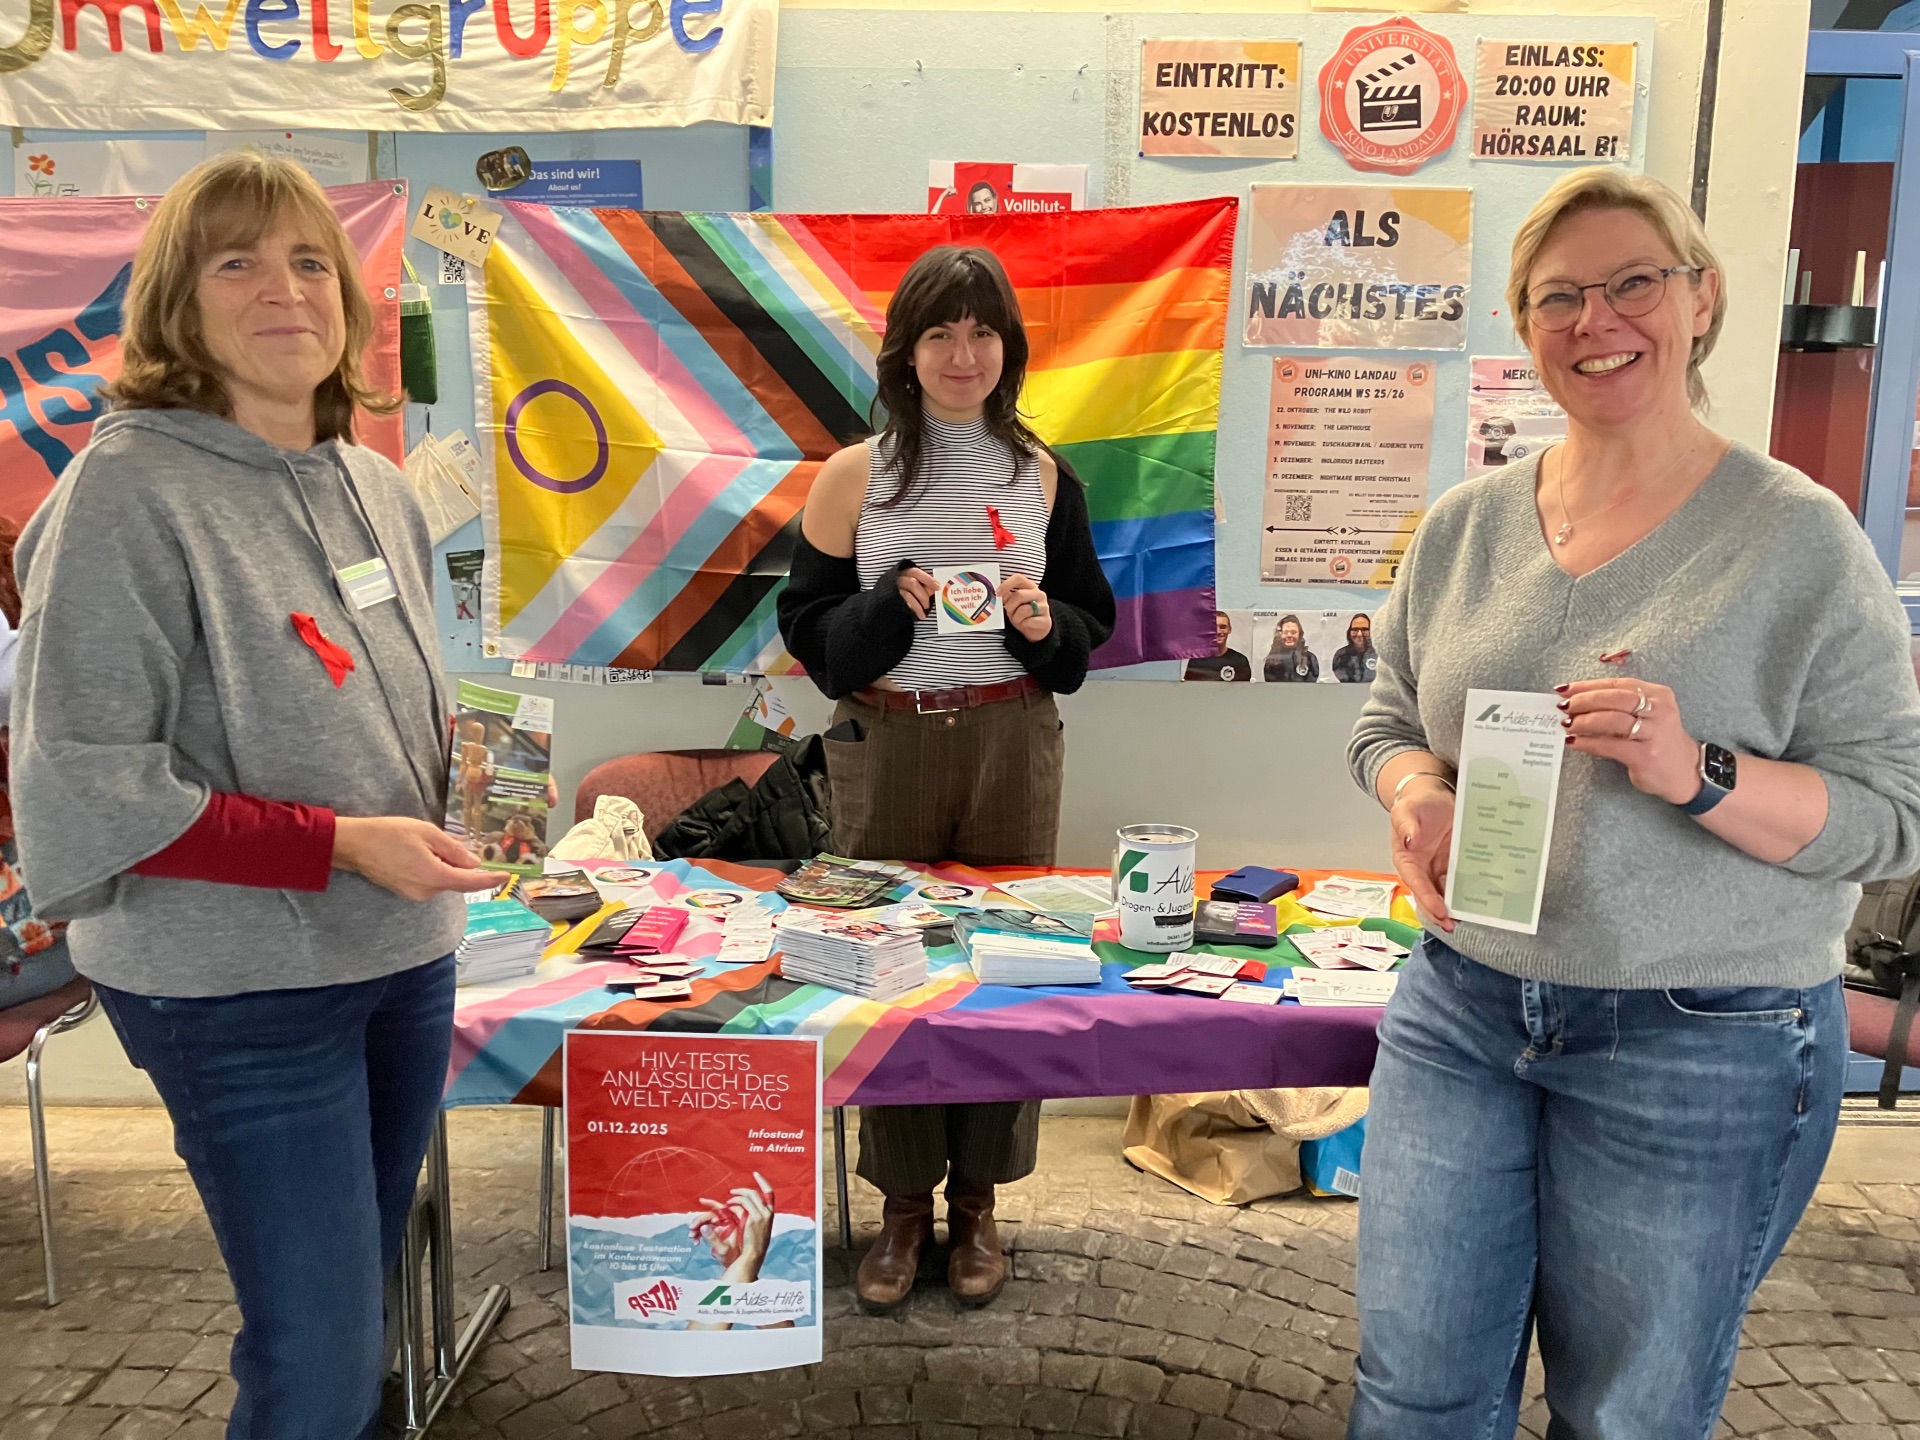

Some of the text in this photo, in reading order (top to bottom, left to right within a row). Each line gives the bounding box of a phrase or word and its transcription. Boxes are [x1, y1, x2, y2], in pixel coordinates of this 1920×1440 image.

[1344, 33, 1450, 76] UNIVERSITÄT
[1504, 44, 1604, 68] EINLASS:
[1156, 62, 1286, 89] EINTRITT:
[1495, 74, 1610, 97] 20:00 UHR
[1142, 111, 1295, 138] KOSTENLOS
[1515, 103, 1588, 128] RAUM:
[1344, 128, 1436, 159] KINO LANDAU
[1480, 128, 1586, 157] HÖRSAAL
[528, 167, 601, 181] Das sind wir!
[548, 183, 581, 192] About us!
[1004, 198, 1066, 213] Vollblut-
[1322, 209, 1401, 248] ALS
[1249, 271, 1465, 322] NÄCHSTES
[1304, 368, 1397, 381] UNI-KINO LANDAU
[1294, 387, 1405, 399] PROGRAMM WS 25/26
[1352, 407, 1372, 415] ROBOT
[1408, 442, 1424, 450] VOTE
[1319, 474, 1352, 482] NIGHTMARE
[1378, 475, 1411, 483] CHRISTMAS
[1501, 710, 1559, 729] Aids-Hilfe
[1508, 800, 1531, 809] Drogen
[1121, 896, 1154, 914] Drogen-
[1157, 902, 1168, 913] &
[641, 1050, 751, 1071] HIV-TESTS
[601, 1068, 790, 1092] ANLÄSSLICH DES
[608, 1089, 782, 1111] WELT-AIDS-TAG
[587, 1121, 669, 1136] 01.12.2025
[748, 1129, 804, 1140] Infostand
[749, 1143, 805, 1153] im Atrium
[593, 1252, 606, 1261] im
[637, 1243, 692, 1254] Teststation
[609, 1262, 667, 1272] 10 bis 15 Uhr
[734, 1290, 805, 1308] Aids-Hilfe
